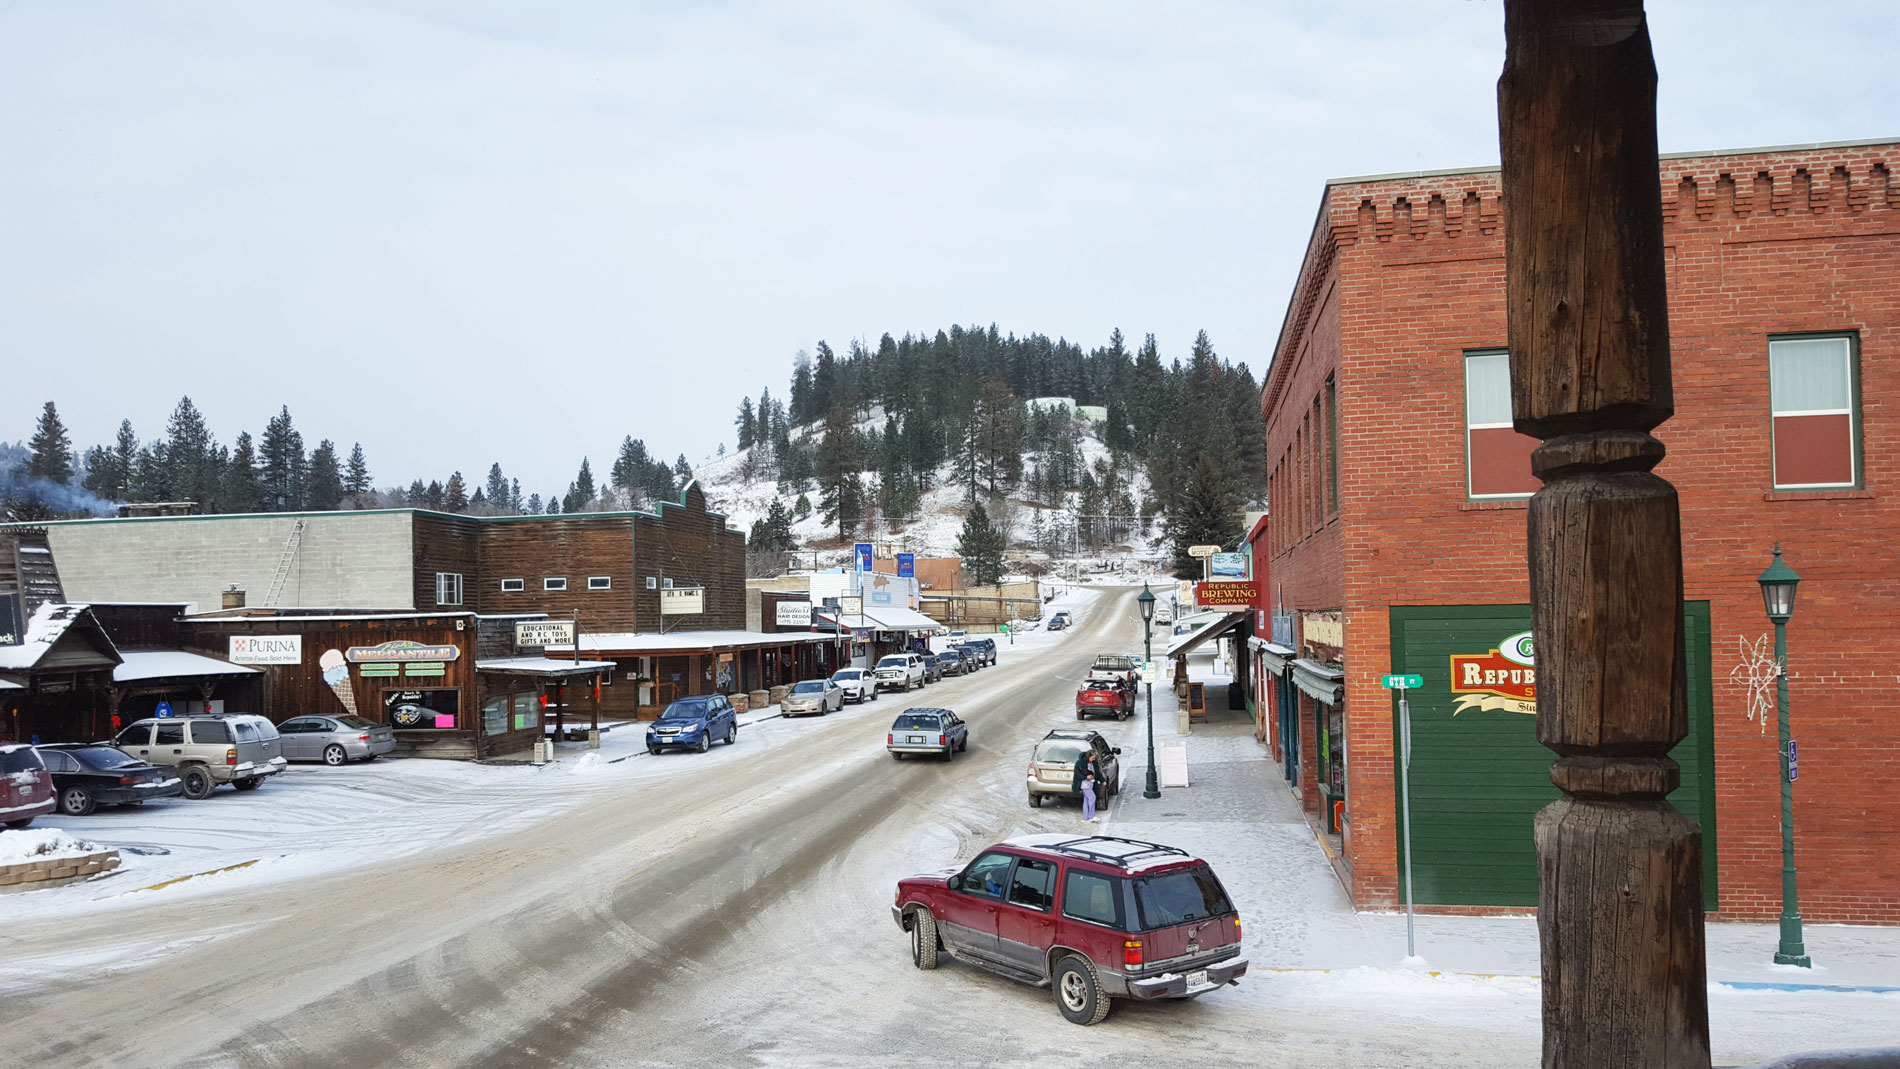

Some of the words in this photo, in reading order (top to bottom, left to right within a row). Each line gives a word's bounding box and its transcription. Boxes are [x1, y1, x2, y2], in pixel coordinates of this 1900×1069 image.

[1201, 590, 1256, 598] BREWING
[249, 640, 296, 652] PURINA
[354, 648, 450, 659] MERCANTILE
[1389, 676, 1404, 686] 6TH
[1524, 688, 1536, 696] S
